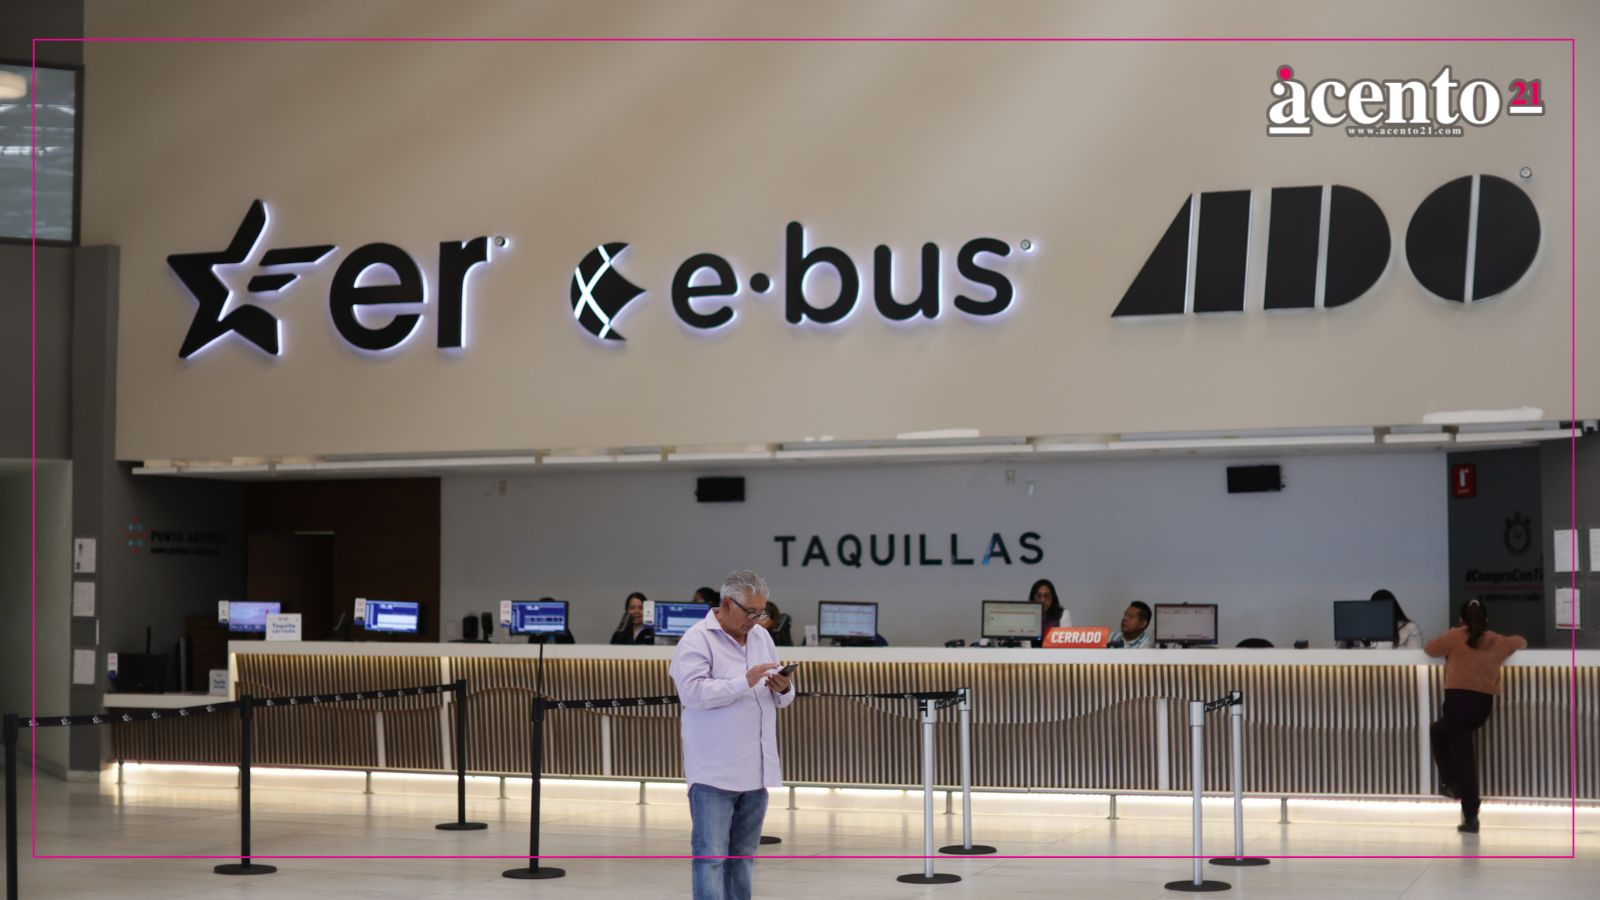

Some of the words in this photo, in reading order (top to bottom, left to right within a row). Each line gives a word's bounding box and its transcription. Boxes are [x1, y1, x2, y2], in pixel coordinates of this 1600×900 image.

[1112, 174, 1541, 317] ADO
[329, 237, 488, 351] er
[774, 532, 1044, 568] TAQUILLAS
[1051, 631, 1102, 644] CERRADO
